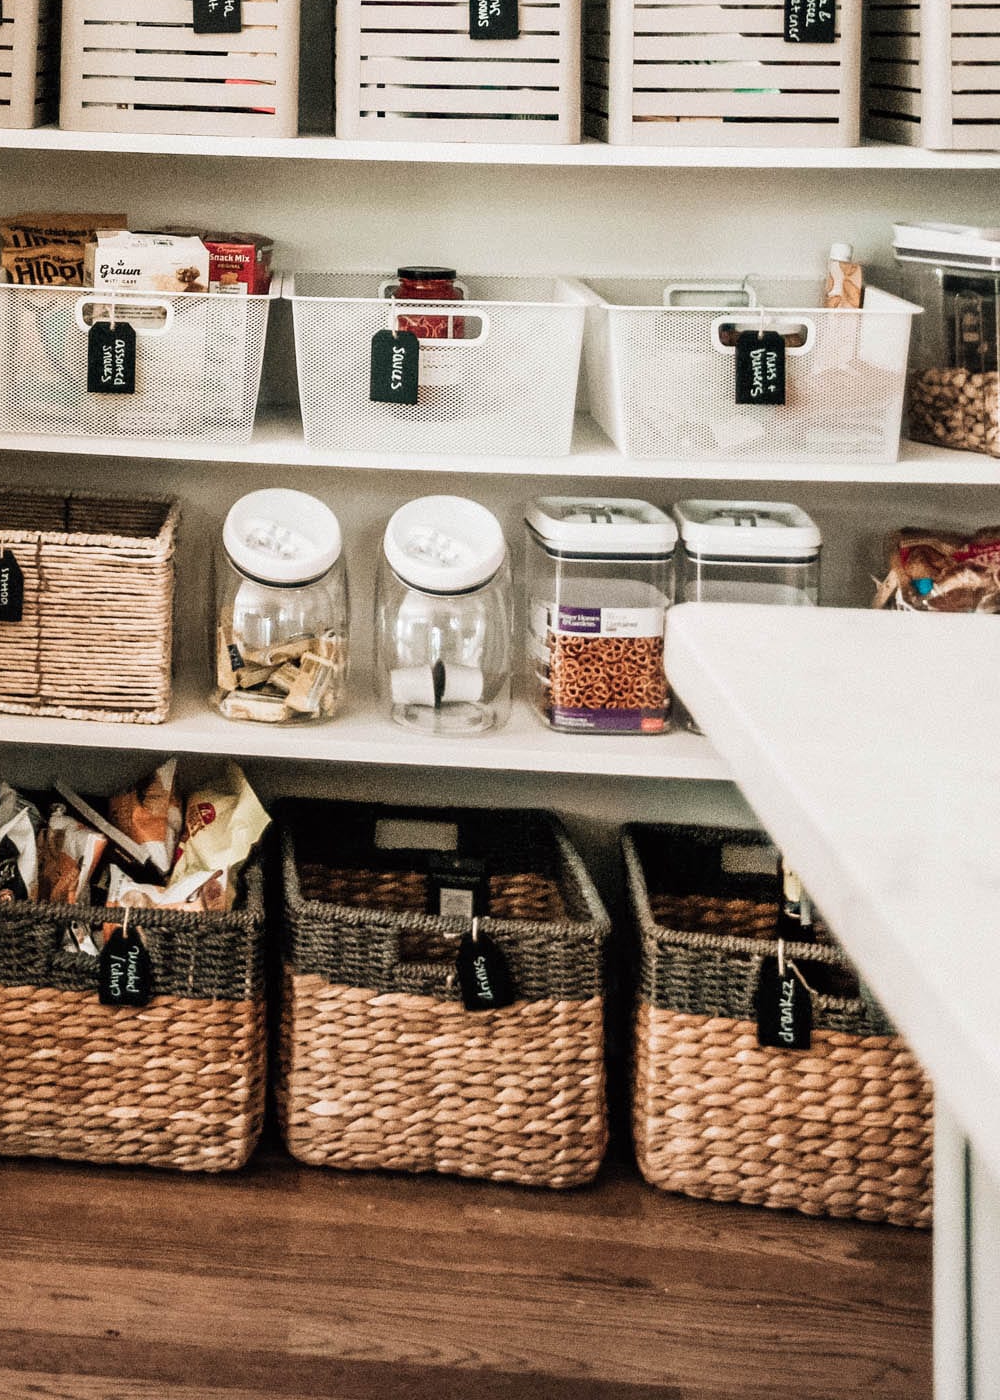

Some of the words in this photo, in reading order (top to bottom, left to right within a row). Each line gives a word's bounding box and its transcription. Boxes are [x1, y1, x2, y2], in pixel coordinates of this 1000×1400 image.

[100, 264, 141, 279] Grown
[209, 253, 233, 262] Snack
[234, 254, 250, 263] Mix
[101, 345, 113, 383] snacks
[113, 339, 126, 386] assorted
[391, 346, 406, 390] sauces
[750, 348, 764, 397] butters
[766, 351, 778, 380] nuts
[109, 954, 126, 996] chips/
[126, 946, 140, 993] popcorn
[473, 955, 493, 1000] drinks
